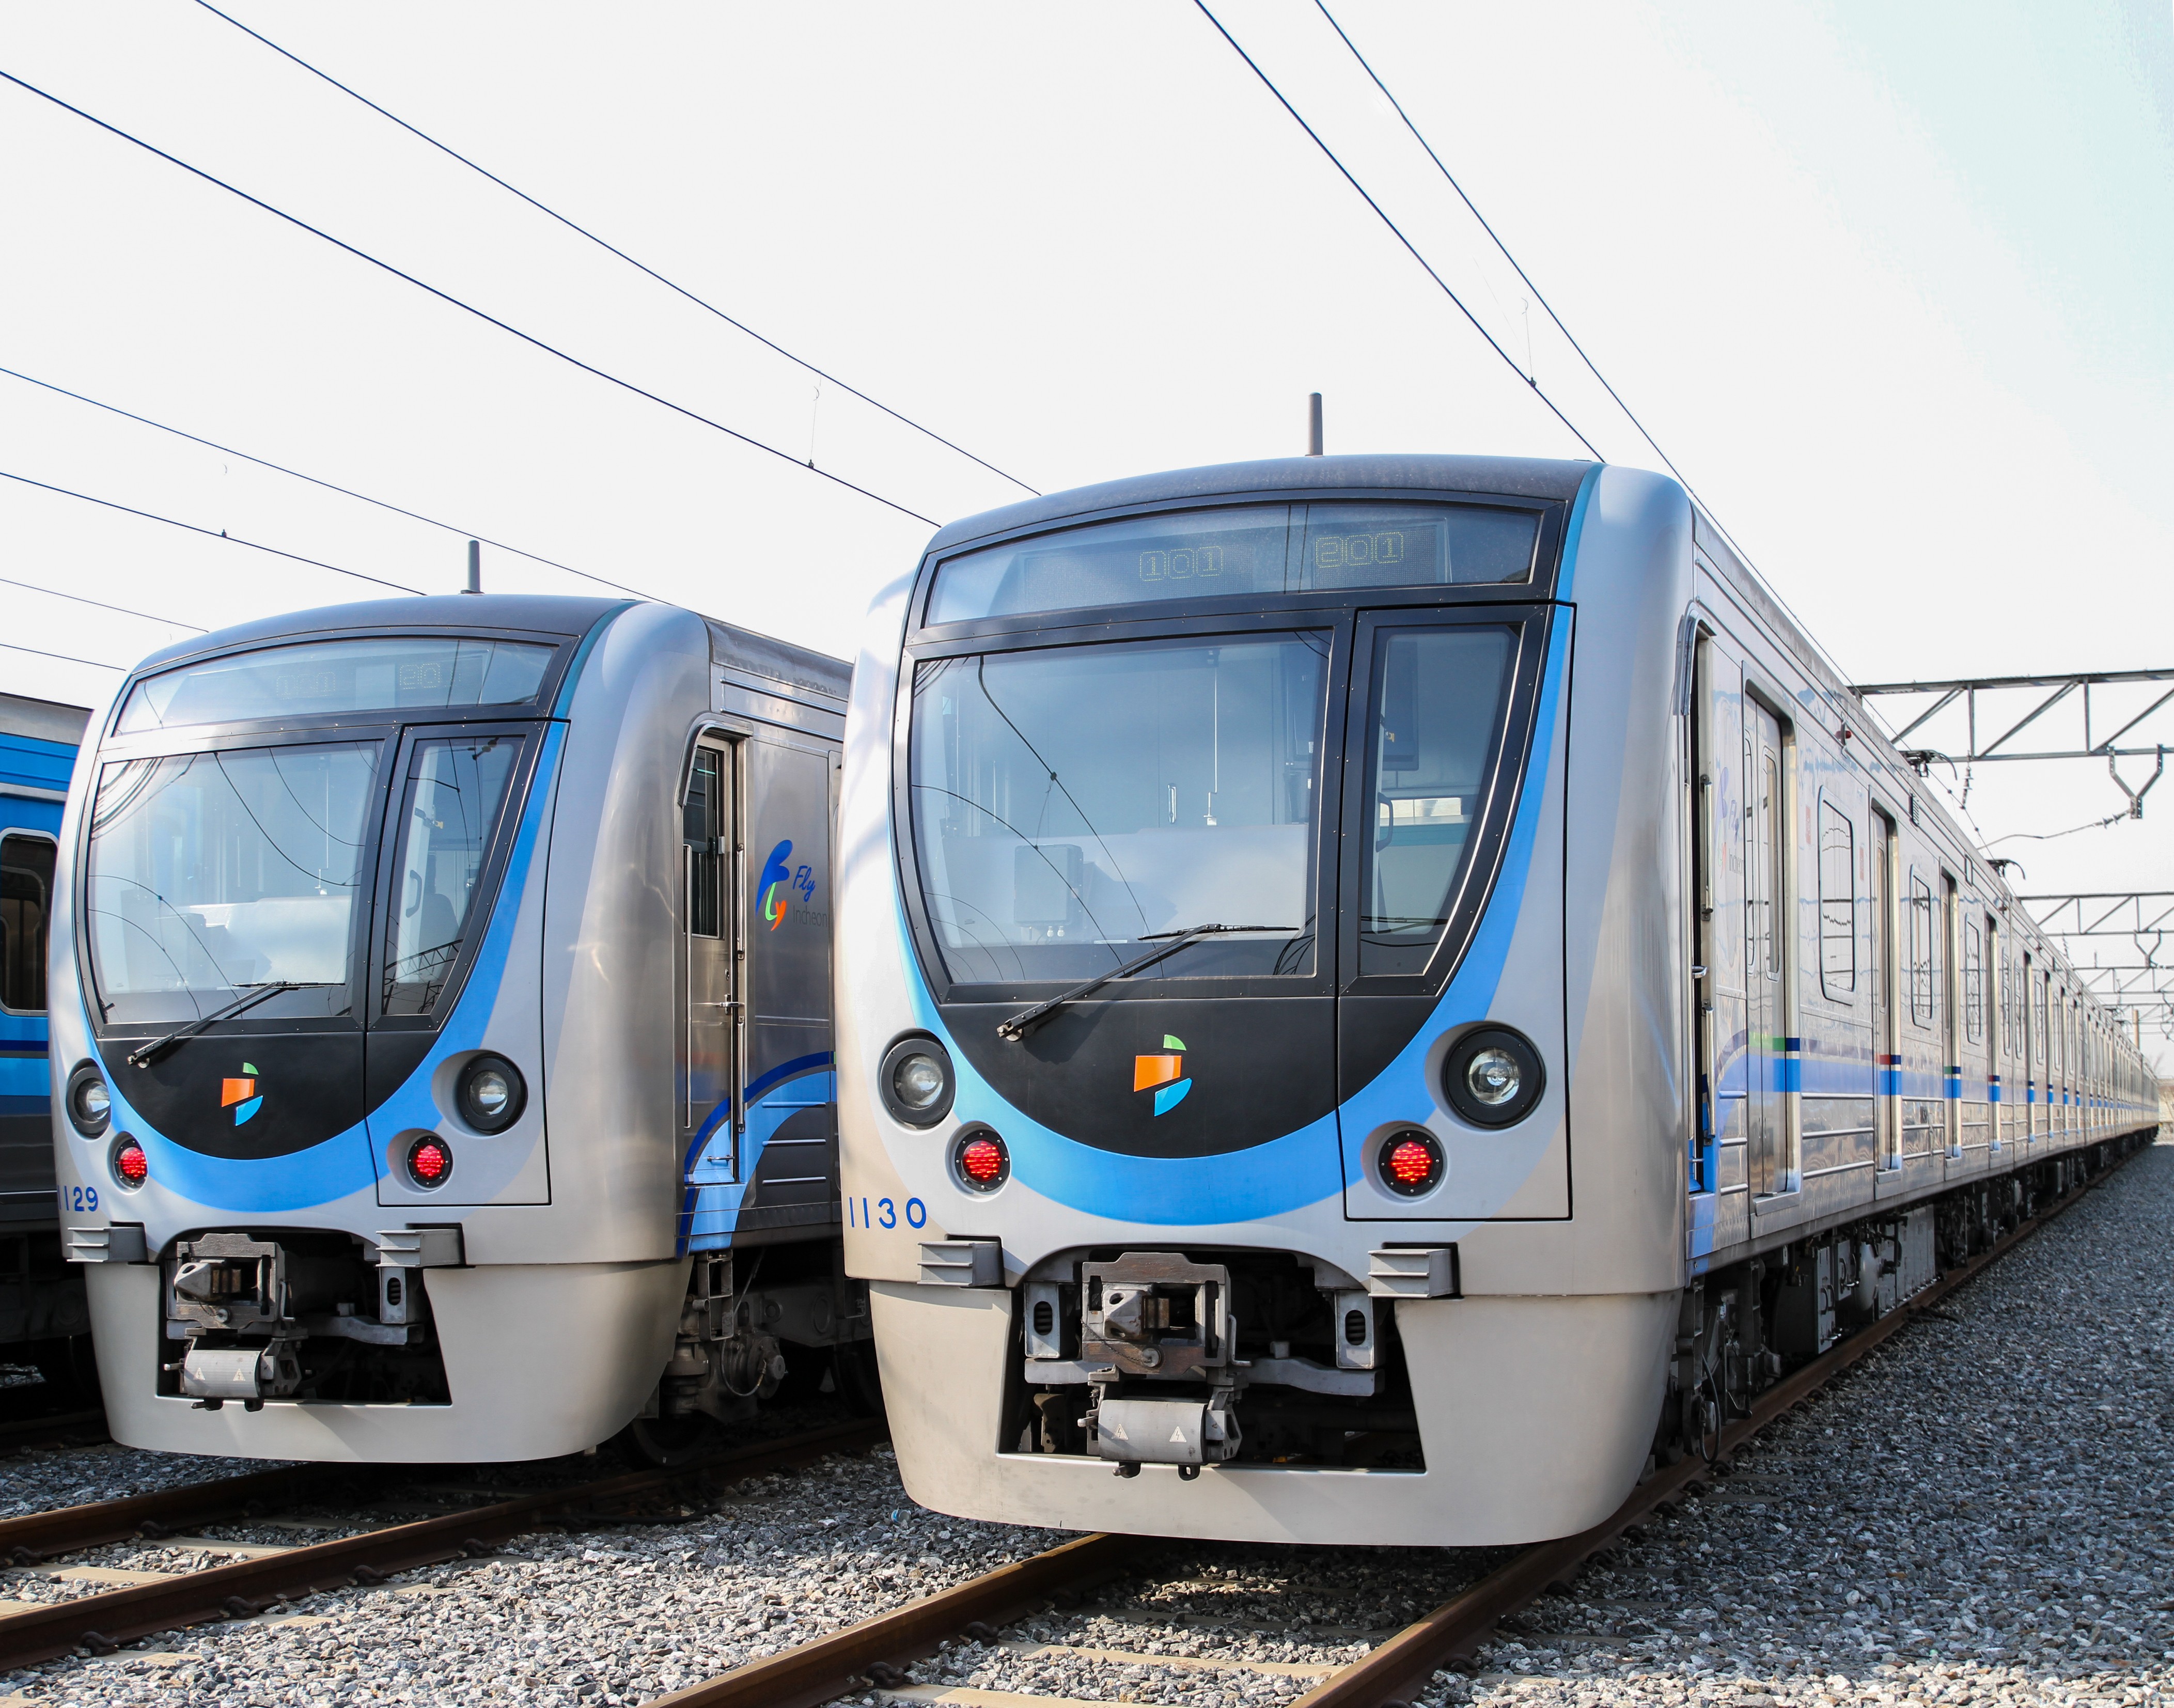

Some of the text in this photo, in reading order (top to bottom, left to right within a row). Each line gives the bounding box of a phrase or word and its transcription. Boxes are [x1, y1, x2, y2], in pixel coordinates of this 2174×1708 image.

[1141, 547, 1221, 579] 101
[1318, 534, 1402, 566] 201
[792, 865, 816, 902] Fly
[793, 905, 827, 928] Incheon
[57, 1185, 99, 1212] 1129
[849, 1197, 927, 1229] 1130
